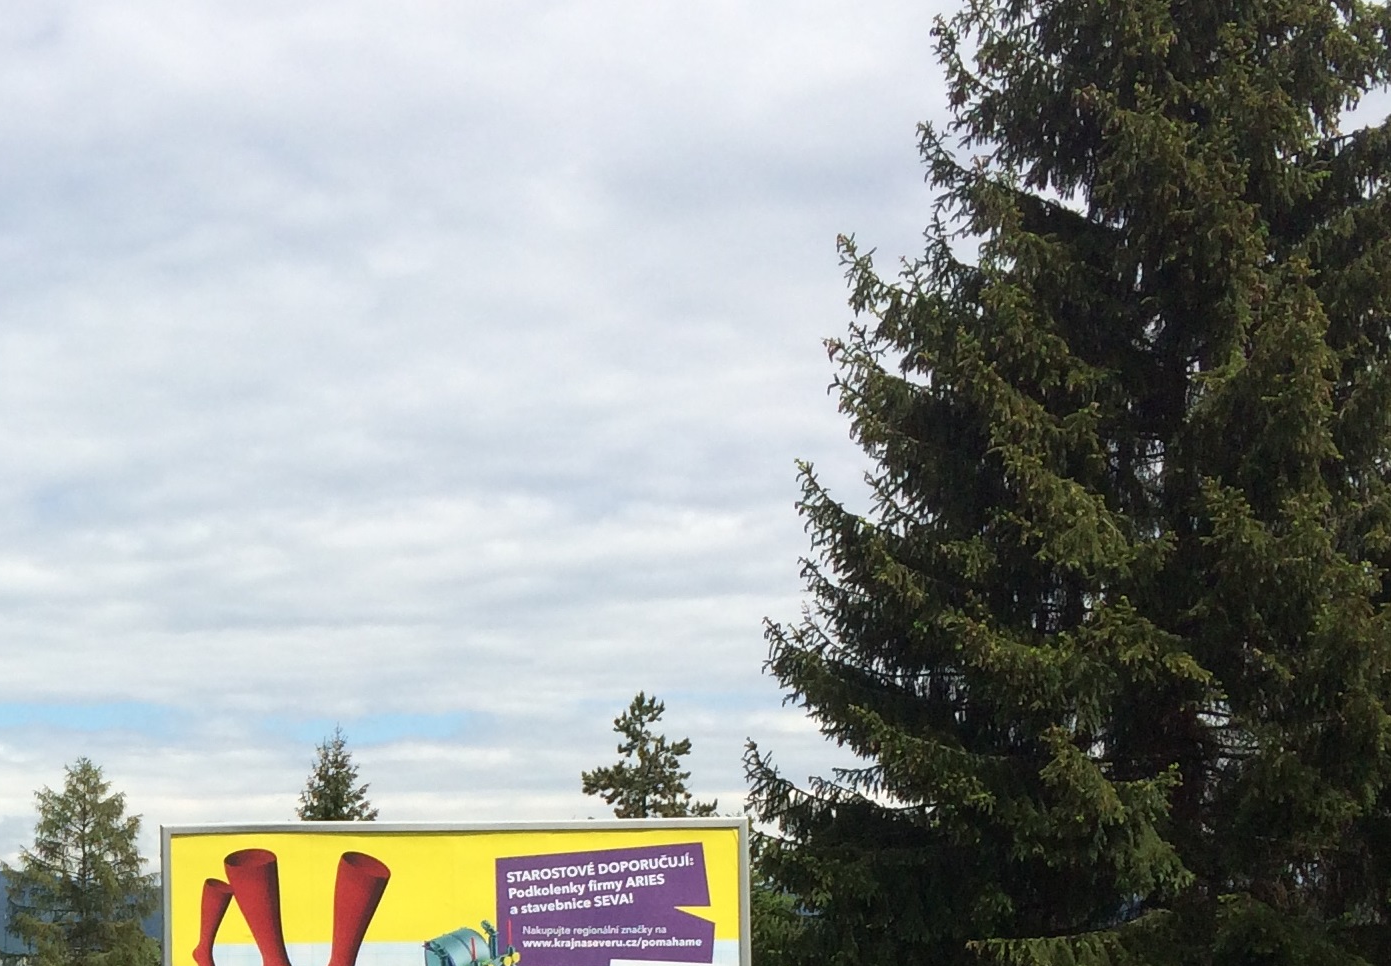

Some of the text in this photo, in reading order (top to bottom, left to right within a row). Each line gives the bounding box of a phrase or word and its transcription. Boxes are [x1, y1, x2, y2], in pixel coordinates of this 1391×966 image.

[507, 853, 694, 883] STAROSTOVÉ DOPORUČUJÍ:
[508, 873, 665, 899] Podkolenky firmy ARIES
[510, 893, 633, 915] a stavebnice SEVA!
[522, 922, 667, 936] Nakupujte regionální značky na
[522, 937, 702, 949] www.krajnaseveru.cz/pomahame
